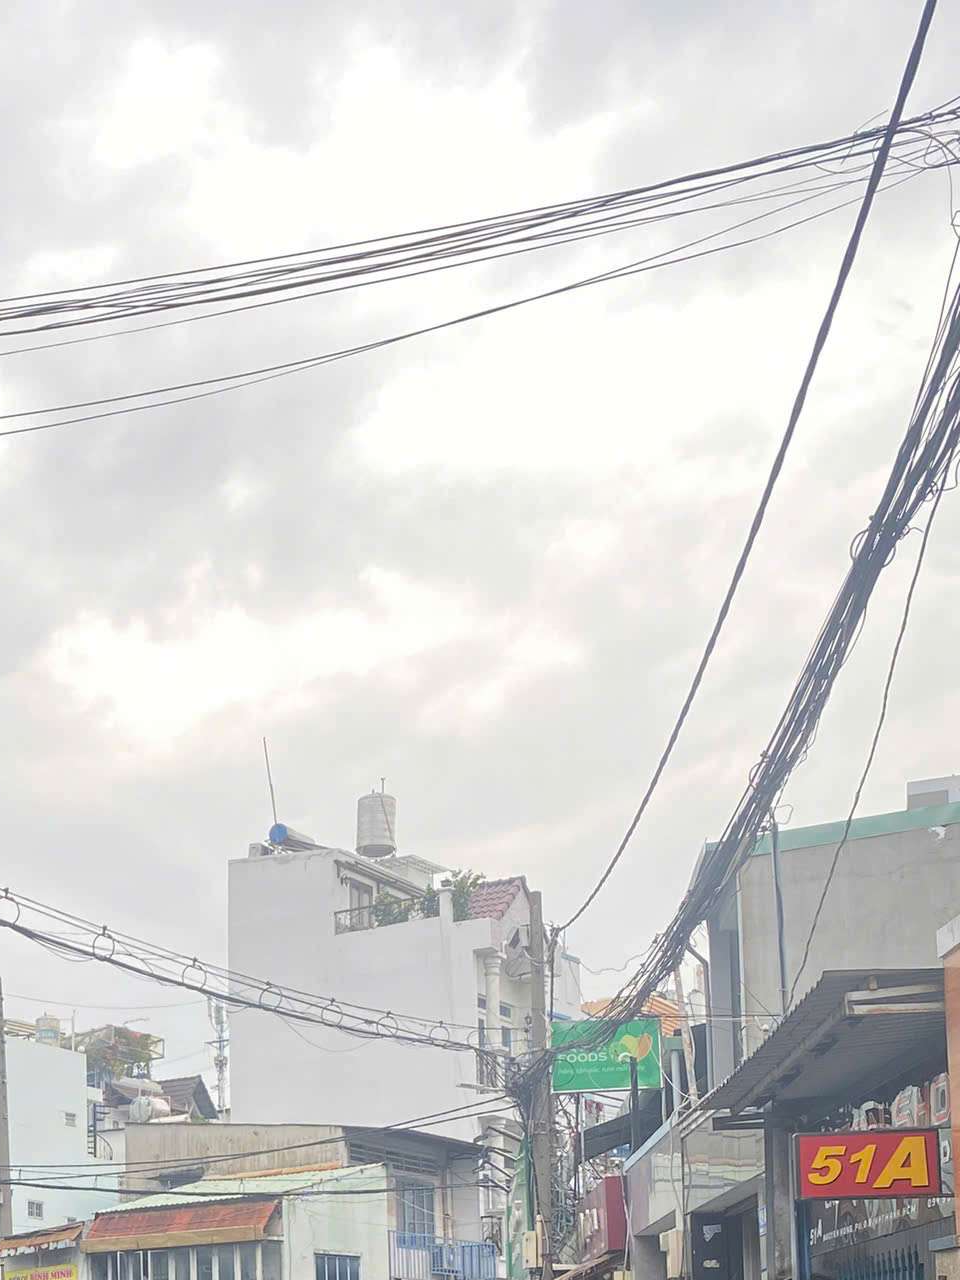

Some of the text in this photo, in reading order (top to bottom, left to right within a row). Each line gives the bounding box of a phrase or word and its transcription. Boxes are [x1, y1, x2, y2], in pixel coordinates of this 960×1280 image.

[557, 1051, 608, 1062] FOODS
[807, 1135, 929, 1189] 51A
[50, 1267, 72, 1279] MINH
